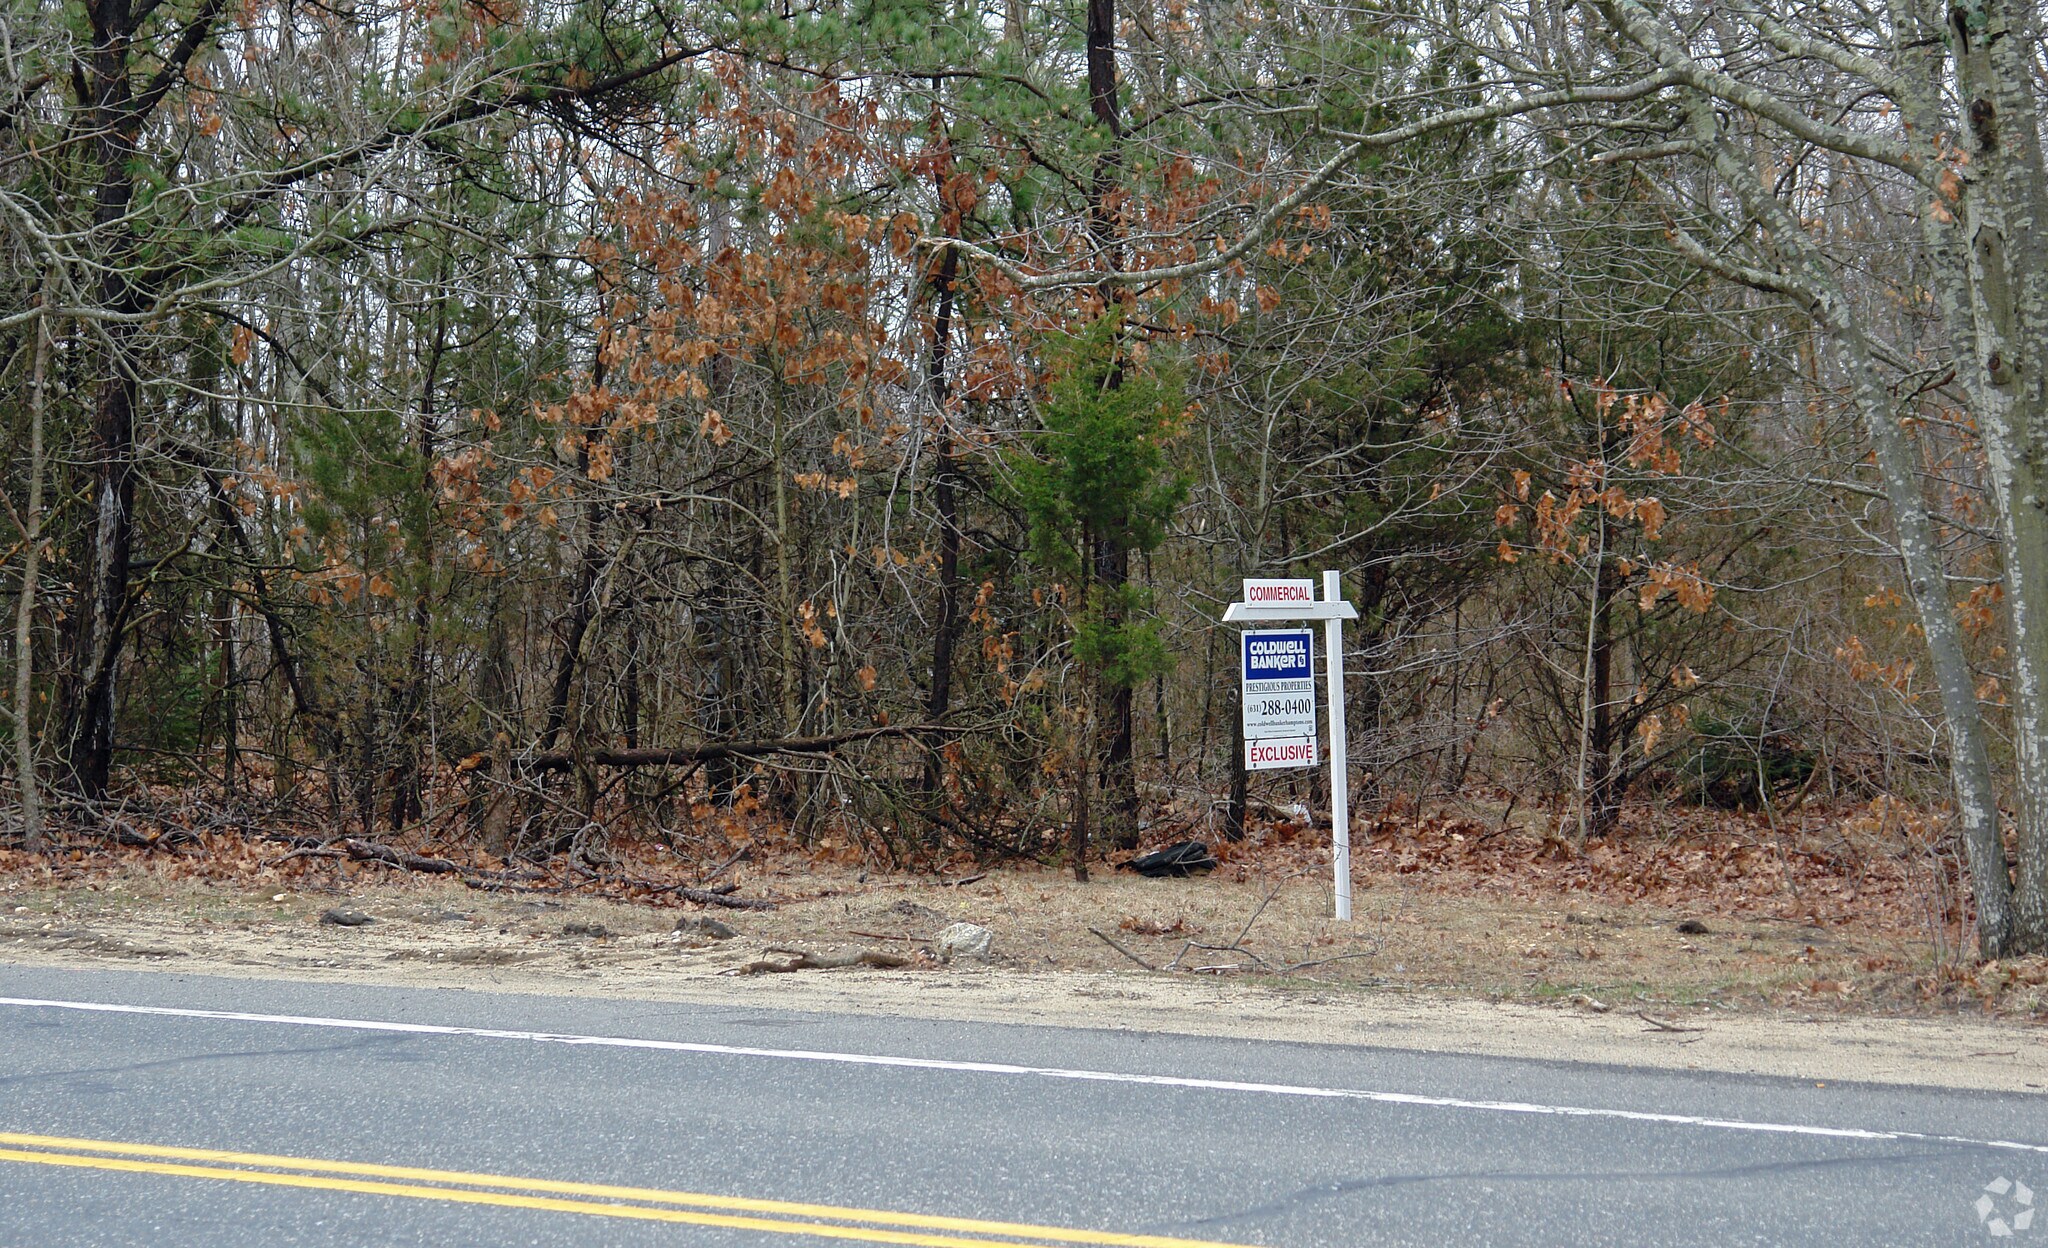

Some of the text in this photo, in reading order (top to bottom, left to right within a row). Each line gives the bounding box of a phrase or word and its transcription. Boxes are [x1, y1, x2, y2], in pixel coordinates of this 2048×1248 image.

[1249, 586, 1310, 601] COMMERCIAL
[1246, 680, 1312, 693] PRESTIGIOUS PROPERTIES
[1250, 745, 1313, 762] EXCLUSIVE
